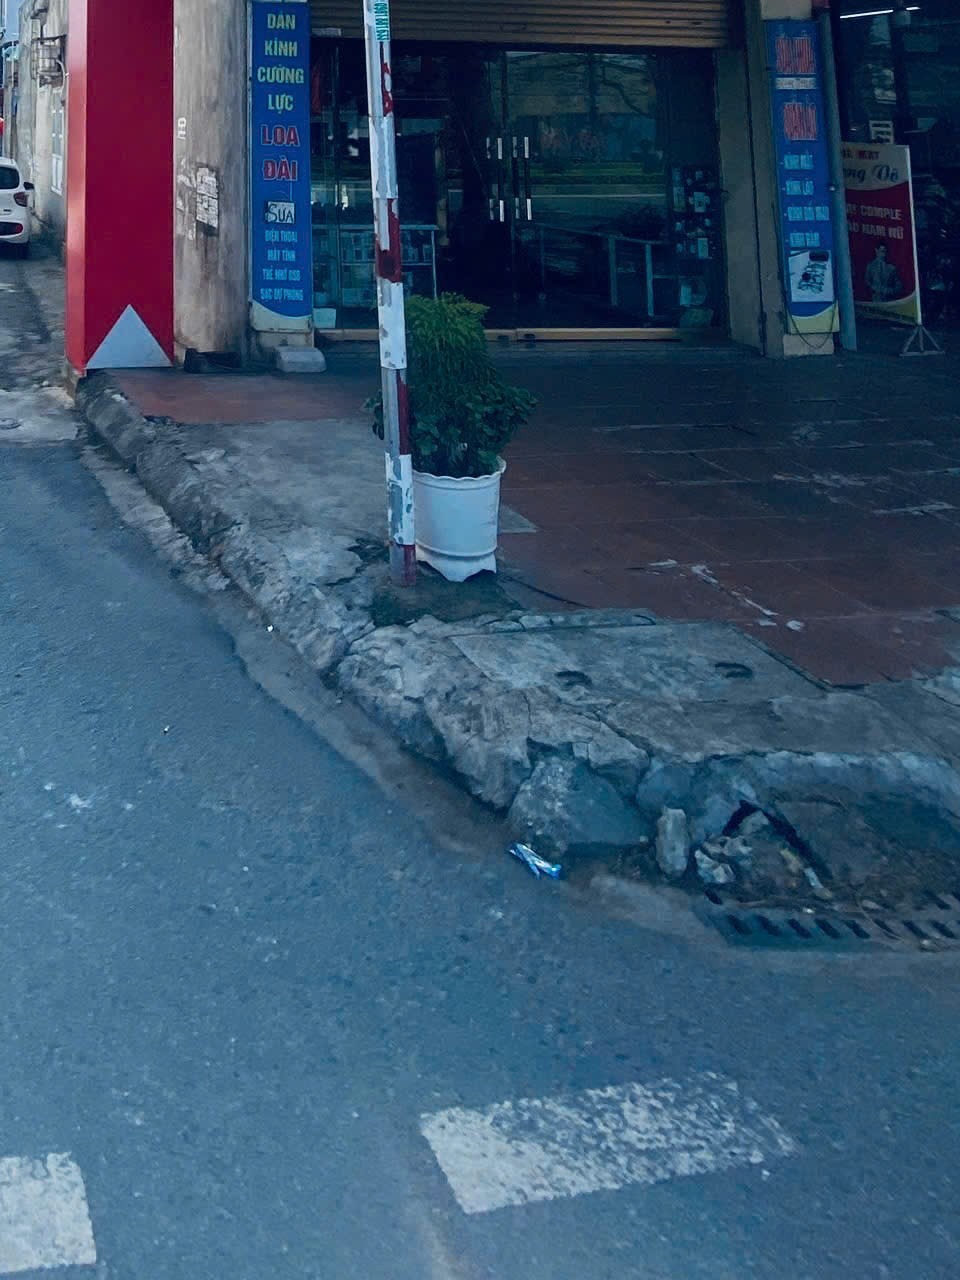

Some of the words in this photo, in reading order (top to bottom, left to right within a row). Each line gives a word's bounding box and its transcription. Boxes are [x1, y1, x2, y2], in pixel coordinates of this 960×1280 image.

[267, 10, 296, 30] DÁN
[264, 37, 298, 57] KÍNH
[257, 63, 305, 84] CƯỜNG
[268, 94, 294, 115] LỰC
[261, 124, 300, 147] LOA
[263, 155, 298, 182] ĐÀI
